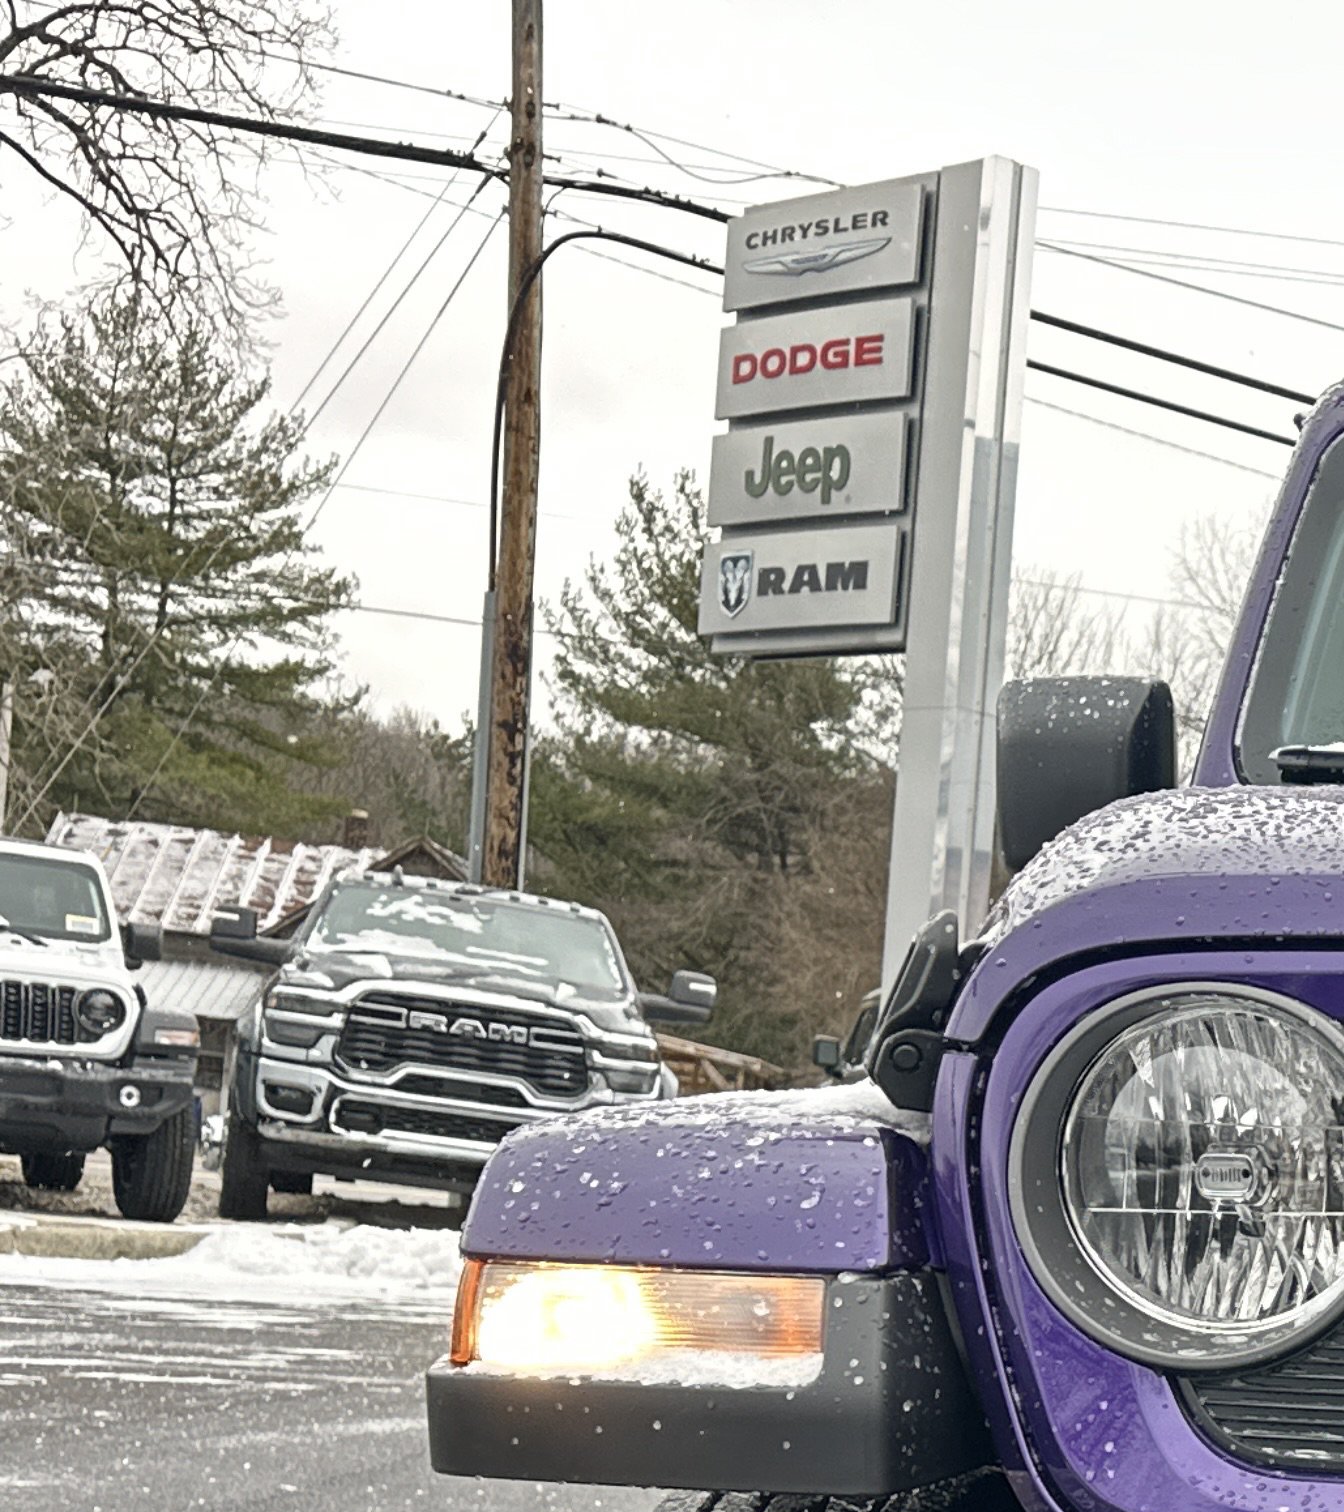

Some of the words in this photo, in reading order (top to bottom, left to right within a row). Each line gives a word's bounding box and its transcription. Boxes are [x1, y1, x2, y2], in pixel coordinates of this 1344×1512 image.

[745, 210, 890, 250] CHRYSLER
[731, 333, 885, 384] DODGE
[744, 436, 851, 505] Jeep
[756, 561, 868, 597] RAM
[408, 1009, 528, 1045] RAM
